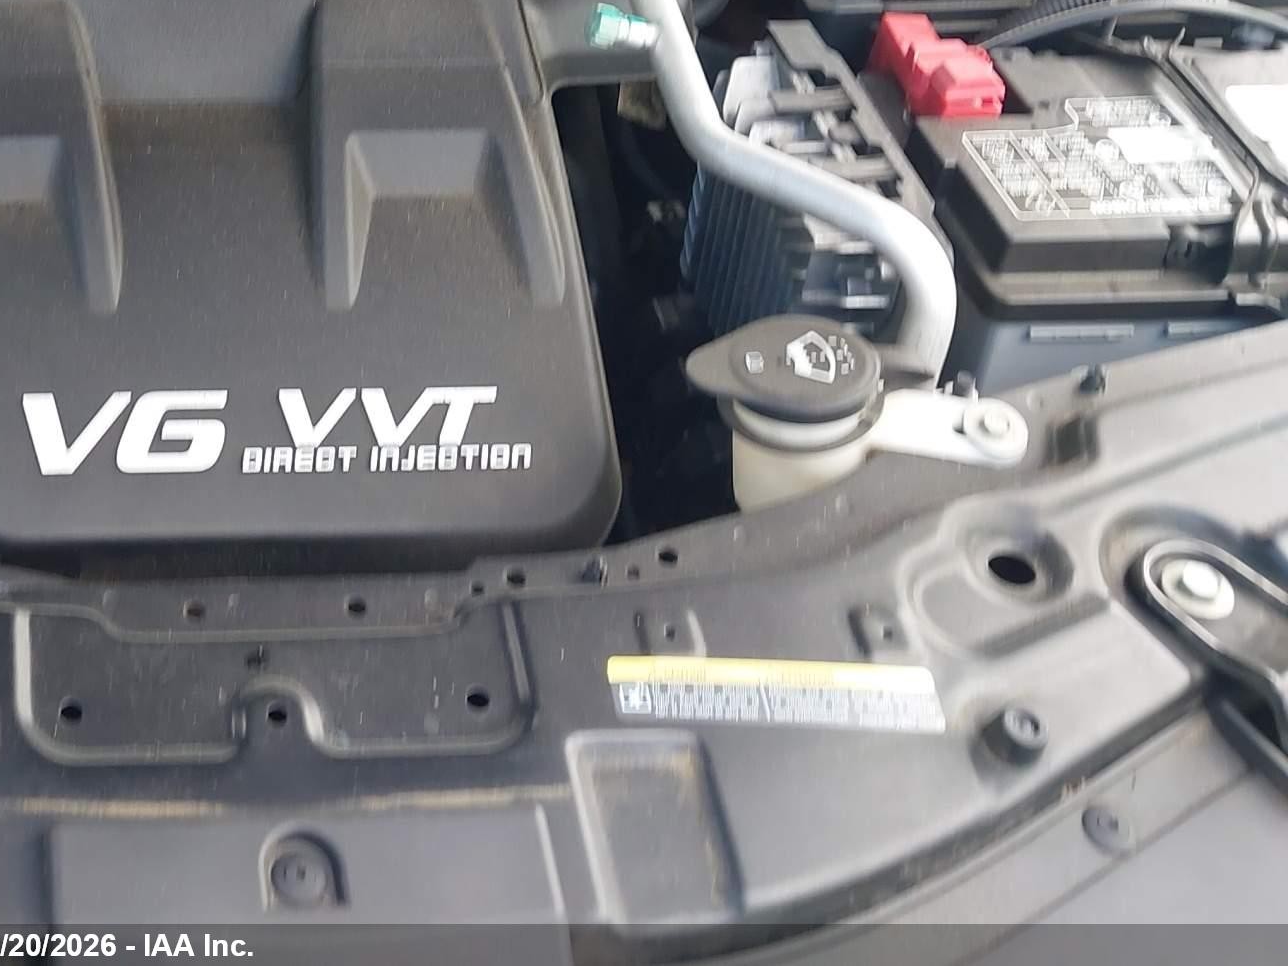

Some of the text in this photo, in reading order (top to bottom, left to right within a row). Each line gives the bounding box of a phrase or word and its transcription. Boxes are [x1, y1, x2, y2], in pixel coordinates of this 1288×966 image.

[22, 385, 498, 476] V6 VVT
[242, 442, 533, 474] DIRECT INJECTION
